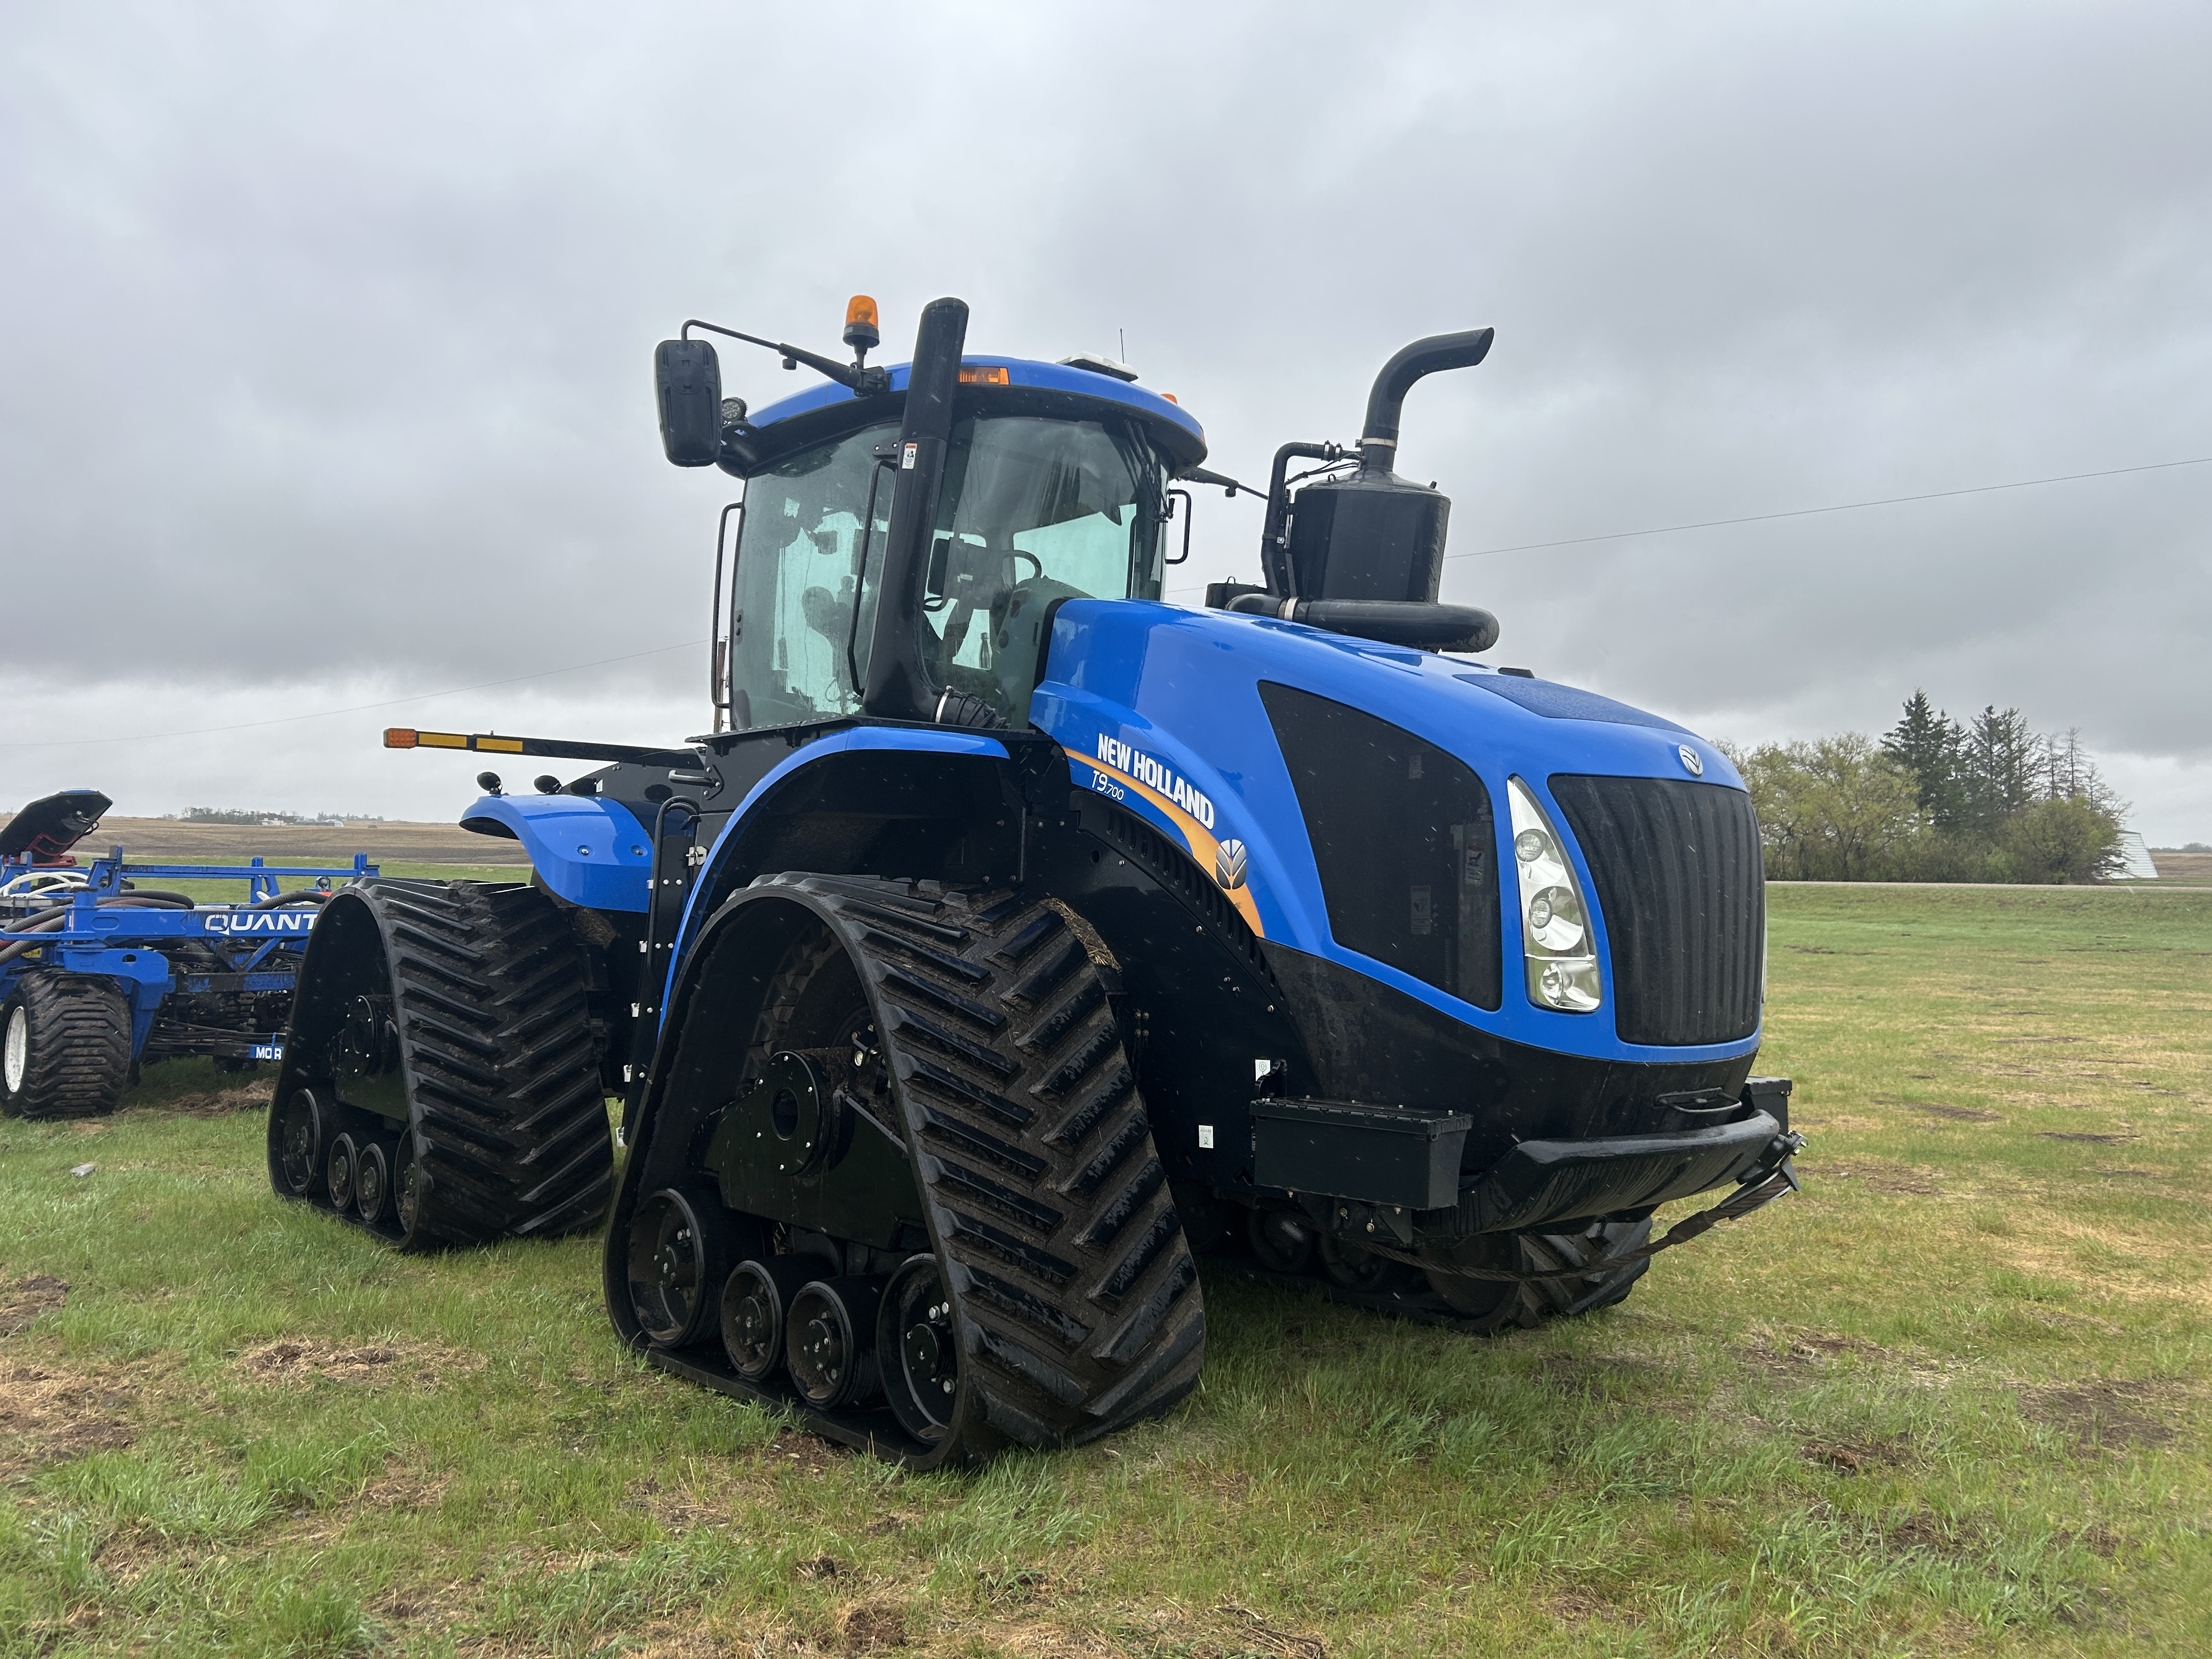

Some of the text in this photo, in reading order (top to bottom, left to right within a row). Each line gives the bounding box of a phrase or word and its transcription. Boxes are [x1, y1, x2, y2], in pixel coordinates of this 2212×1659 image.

[1092, 770, 1124, 801] T9.700
[1097, 733, 1215, 830] NEW HOLLAND
